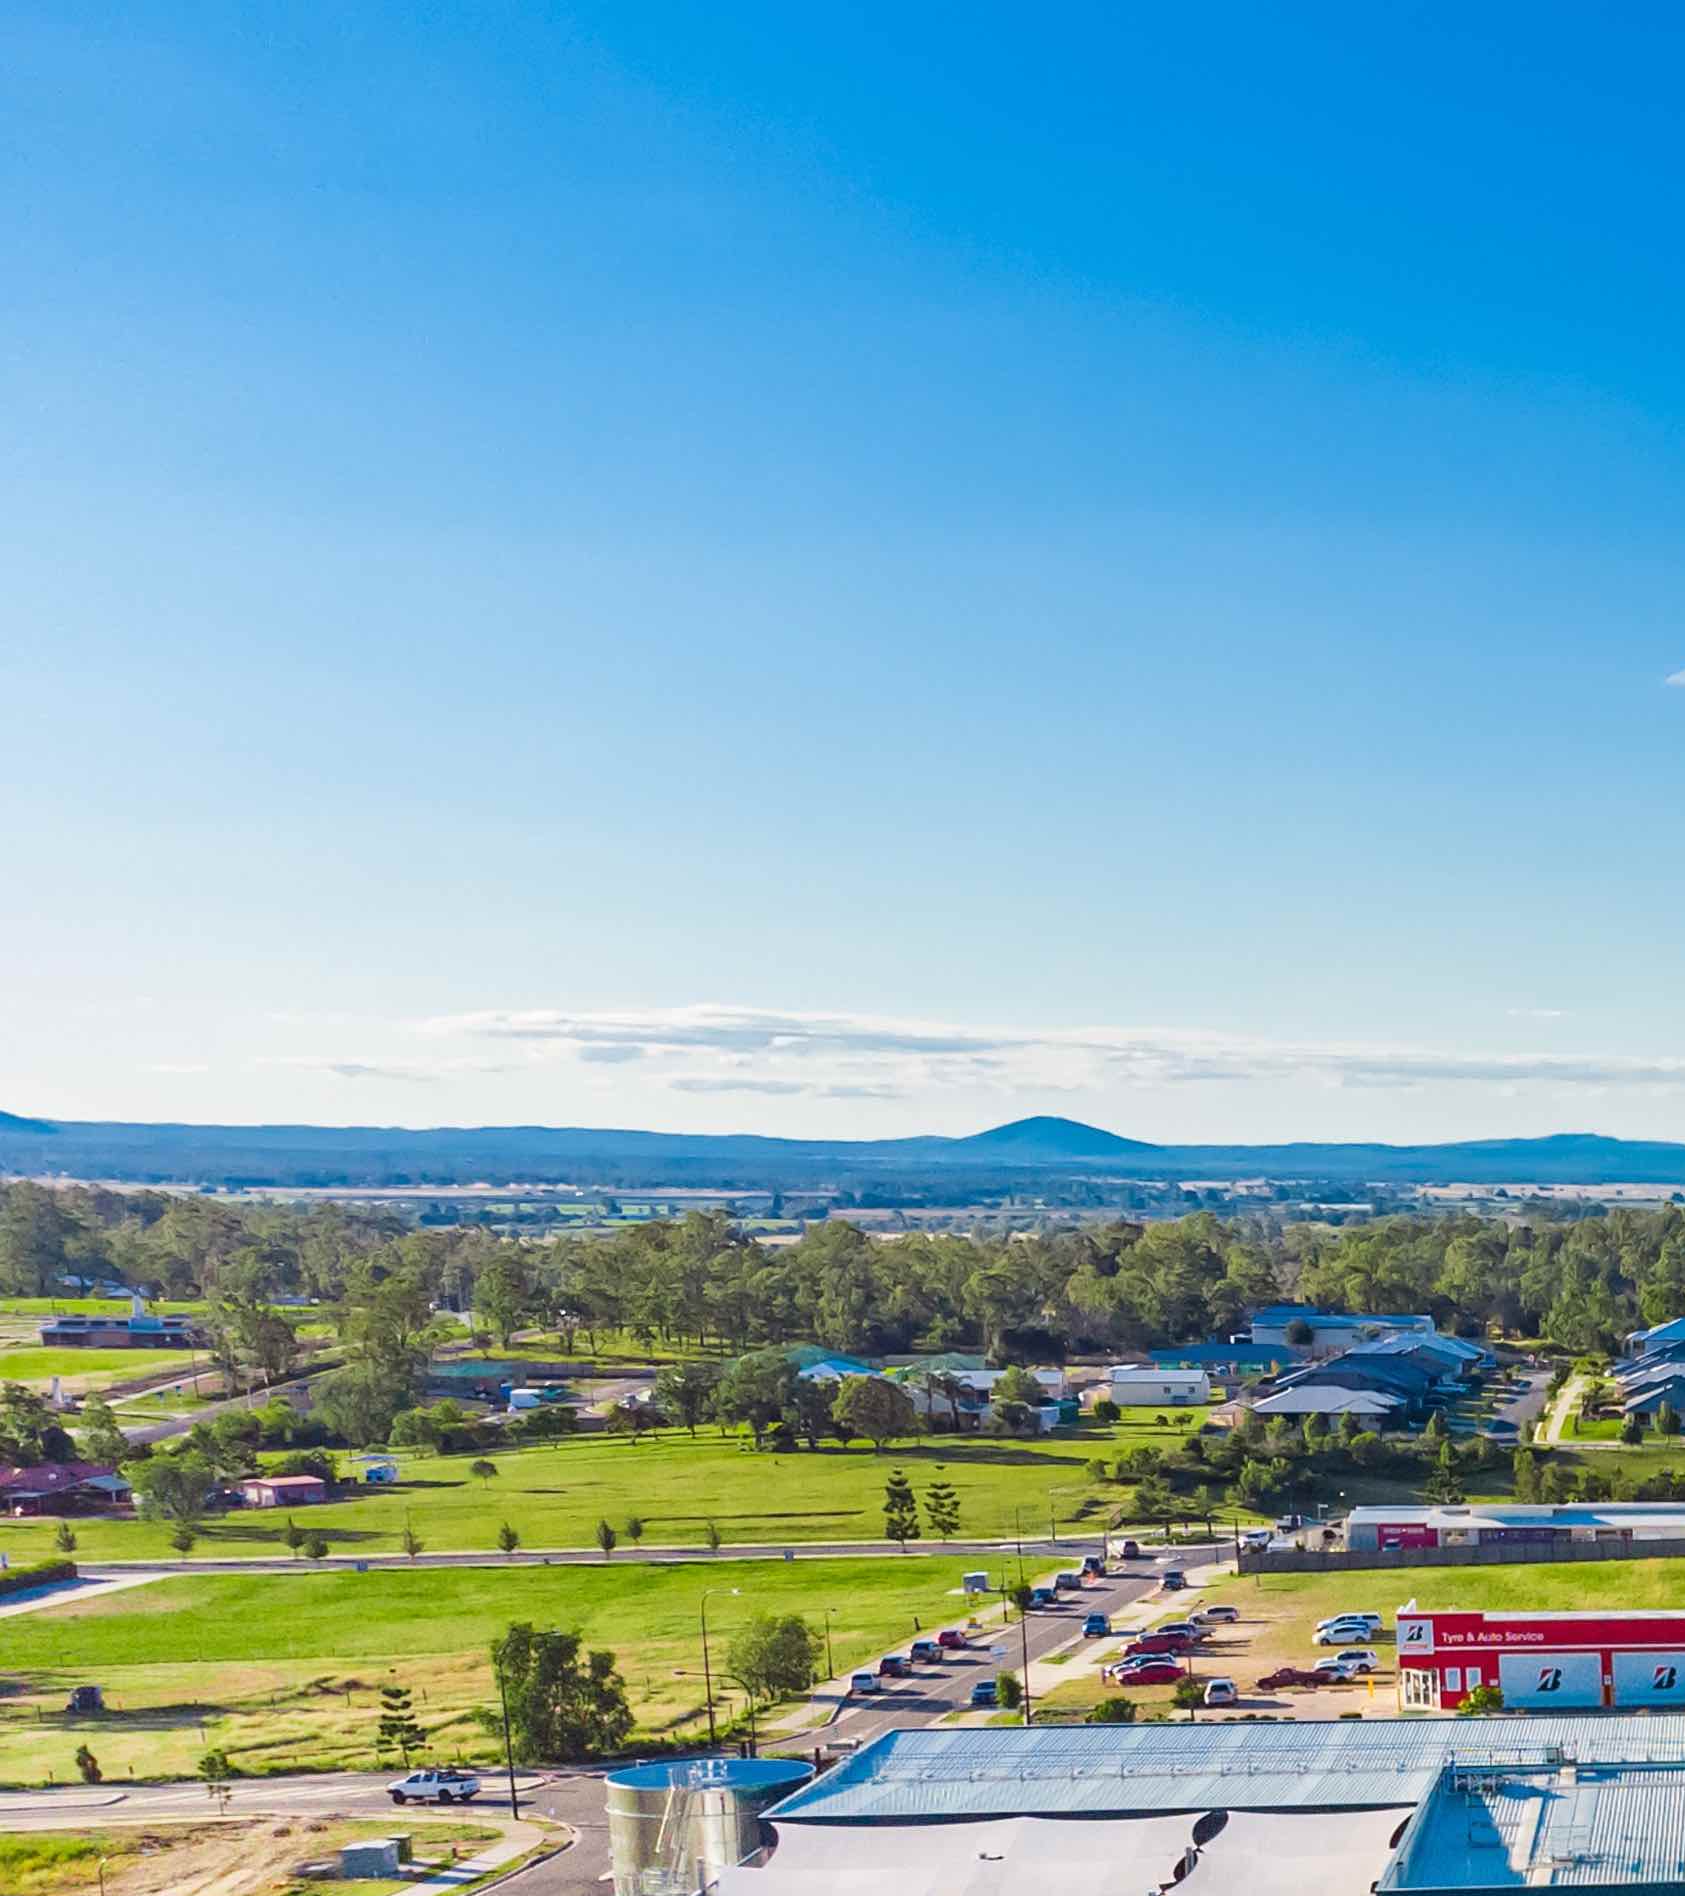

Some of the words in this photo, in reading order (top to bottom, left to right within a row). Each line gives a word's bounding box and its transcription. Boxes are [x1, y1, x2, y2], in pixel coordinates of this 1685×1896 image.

[1442, 1632, 1464, 1643] Tyre
[1467, 1632, 1475, 1642] &
[1477, 1632, 1503, 1642] Auto
[1505, 1631, 1544, 1642] Service
